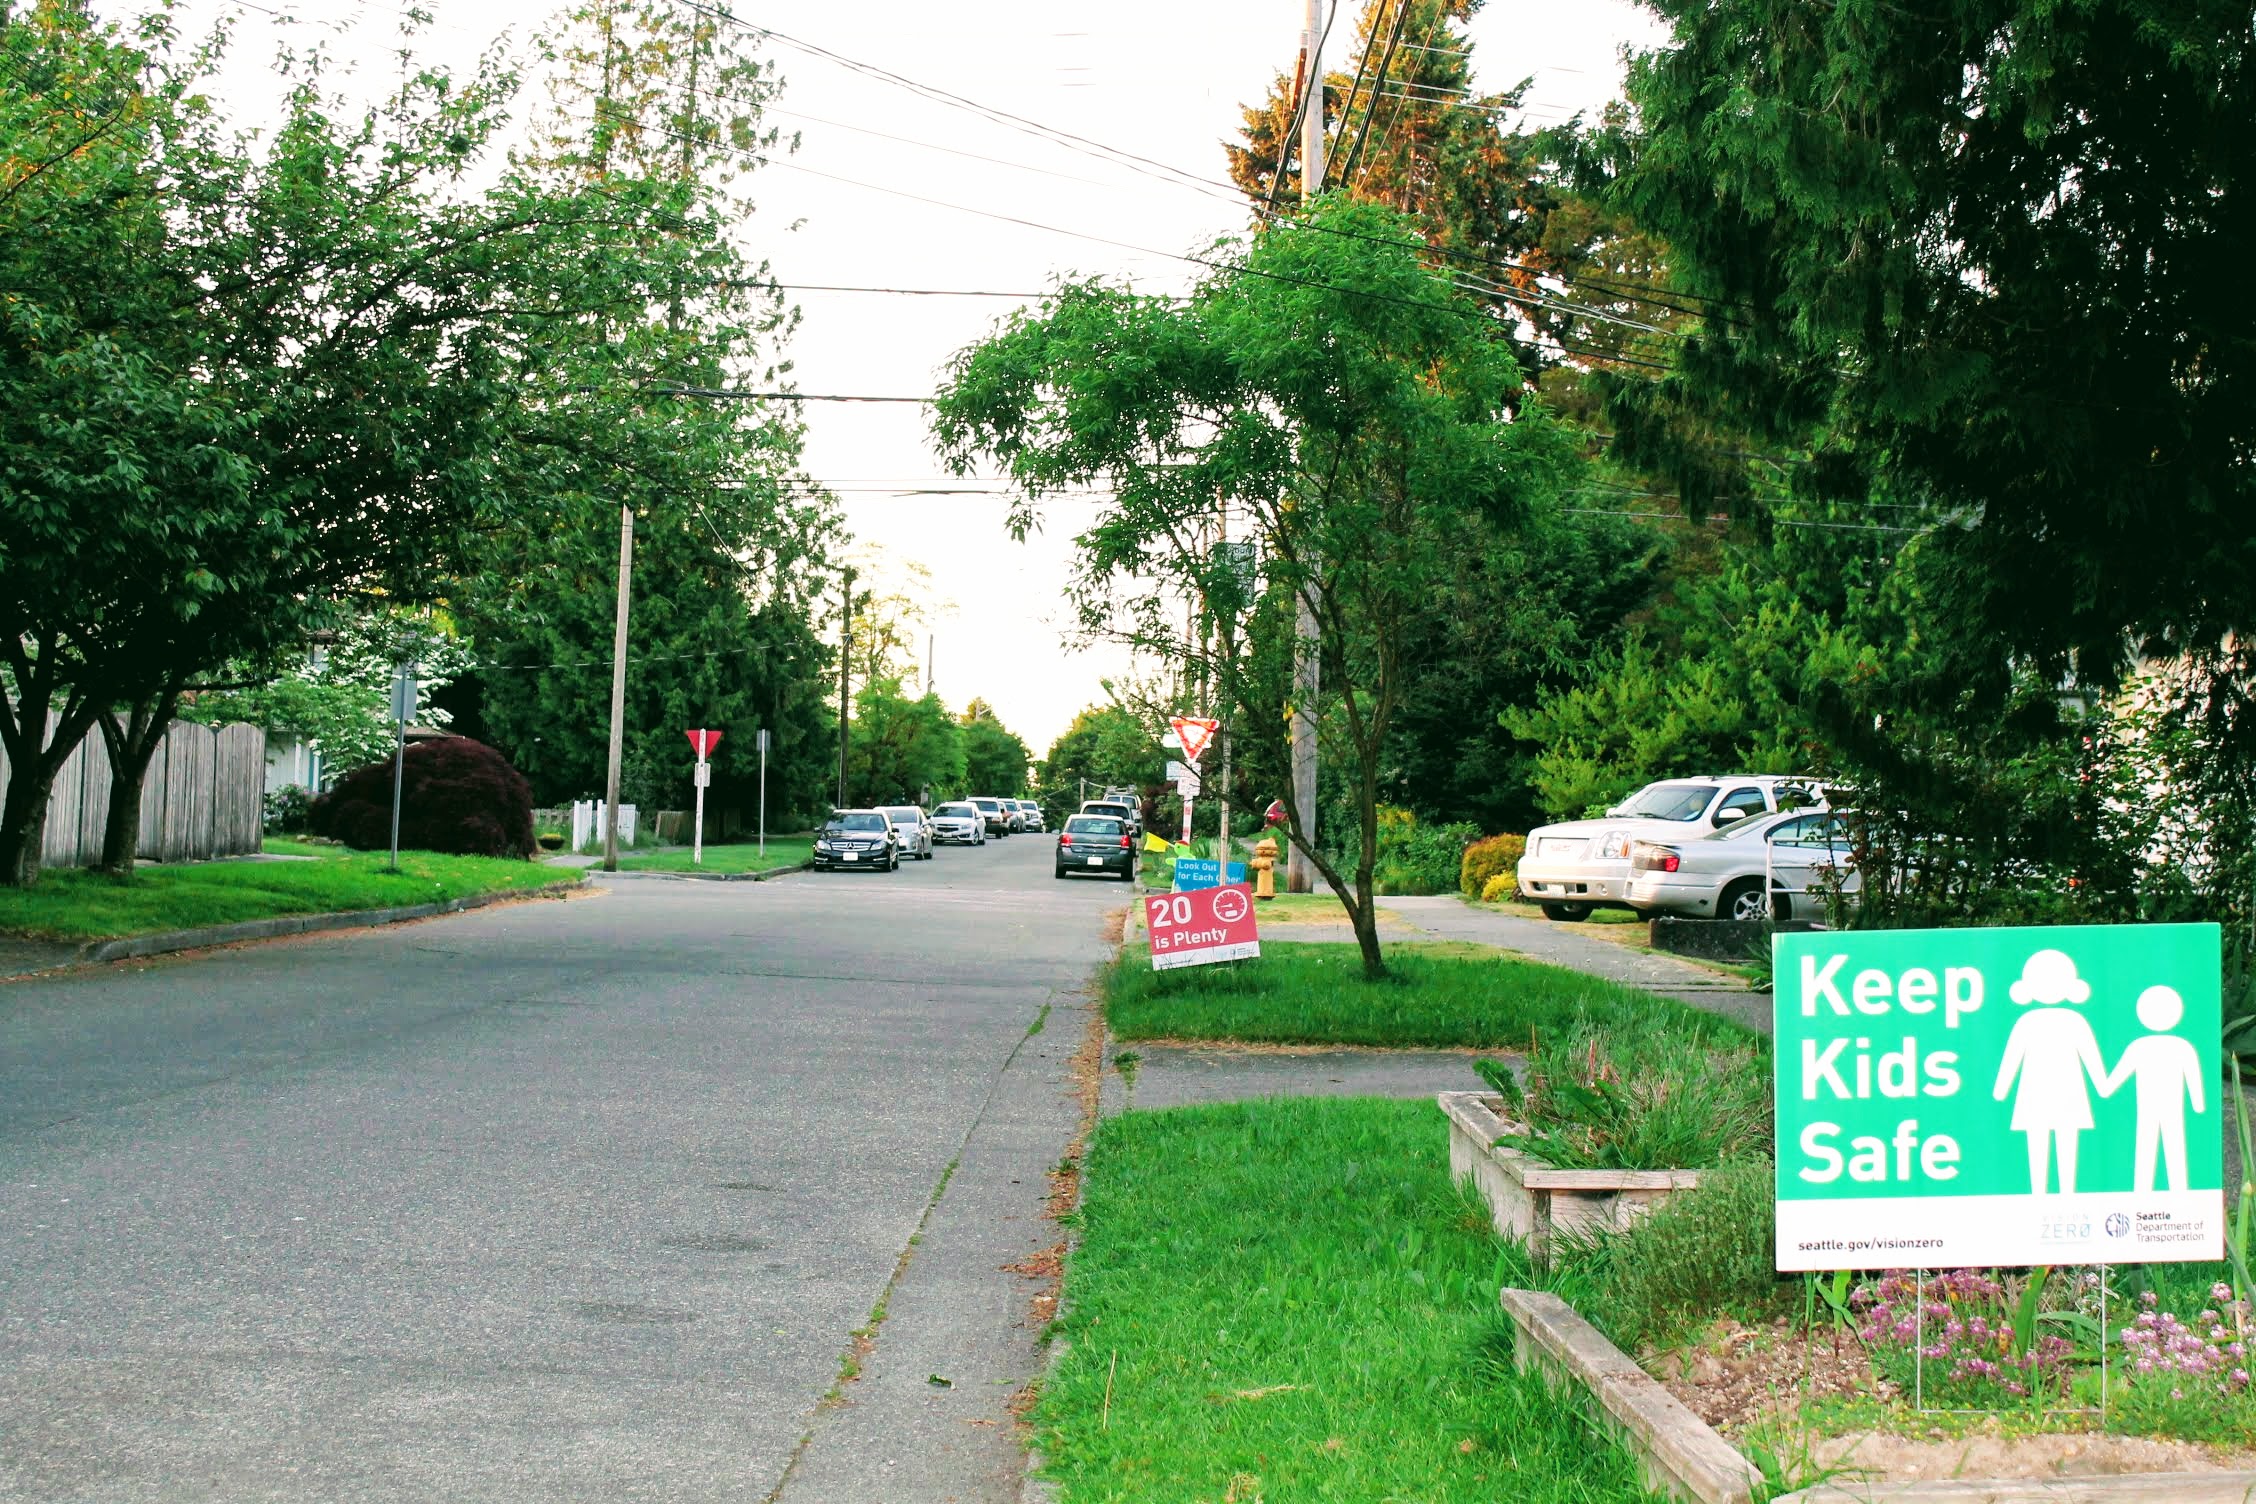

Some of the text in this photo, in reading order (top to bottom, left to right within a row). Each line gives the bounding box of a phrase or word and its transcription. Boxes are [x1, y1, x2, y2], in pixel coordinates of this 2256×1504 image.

[1178, 861, 1217, 871] Look Out
[1178, 872, 1241, 883] for Each Oher
[1151, 896, 1192, 928] 20
[1154, 927, 1227, 949] is Plenty
[1799, 953, 1985, 1029] Keep
[1800, 1036, 1962, 1100] Kids
[1798, 1119, 1961, 1183] Safe
[2136, 1211, 2171, 1221] Seattle
[2136, 1221, 2204, 1233] Department of
[1798, 1237, 1944, 1252] seattle.gov/visionzero
[2136, 1232, 2204, 1243] Transportation
